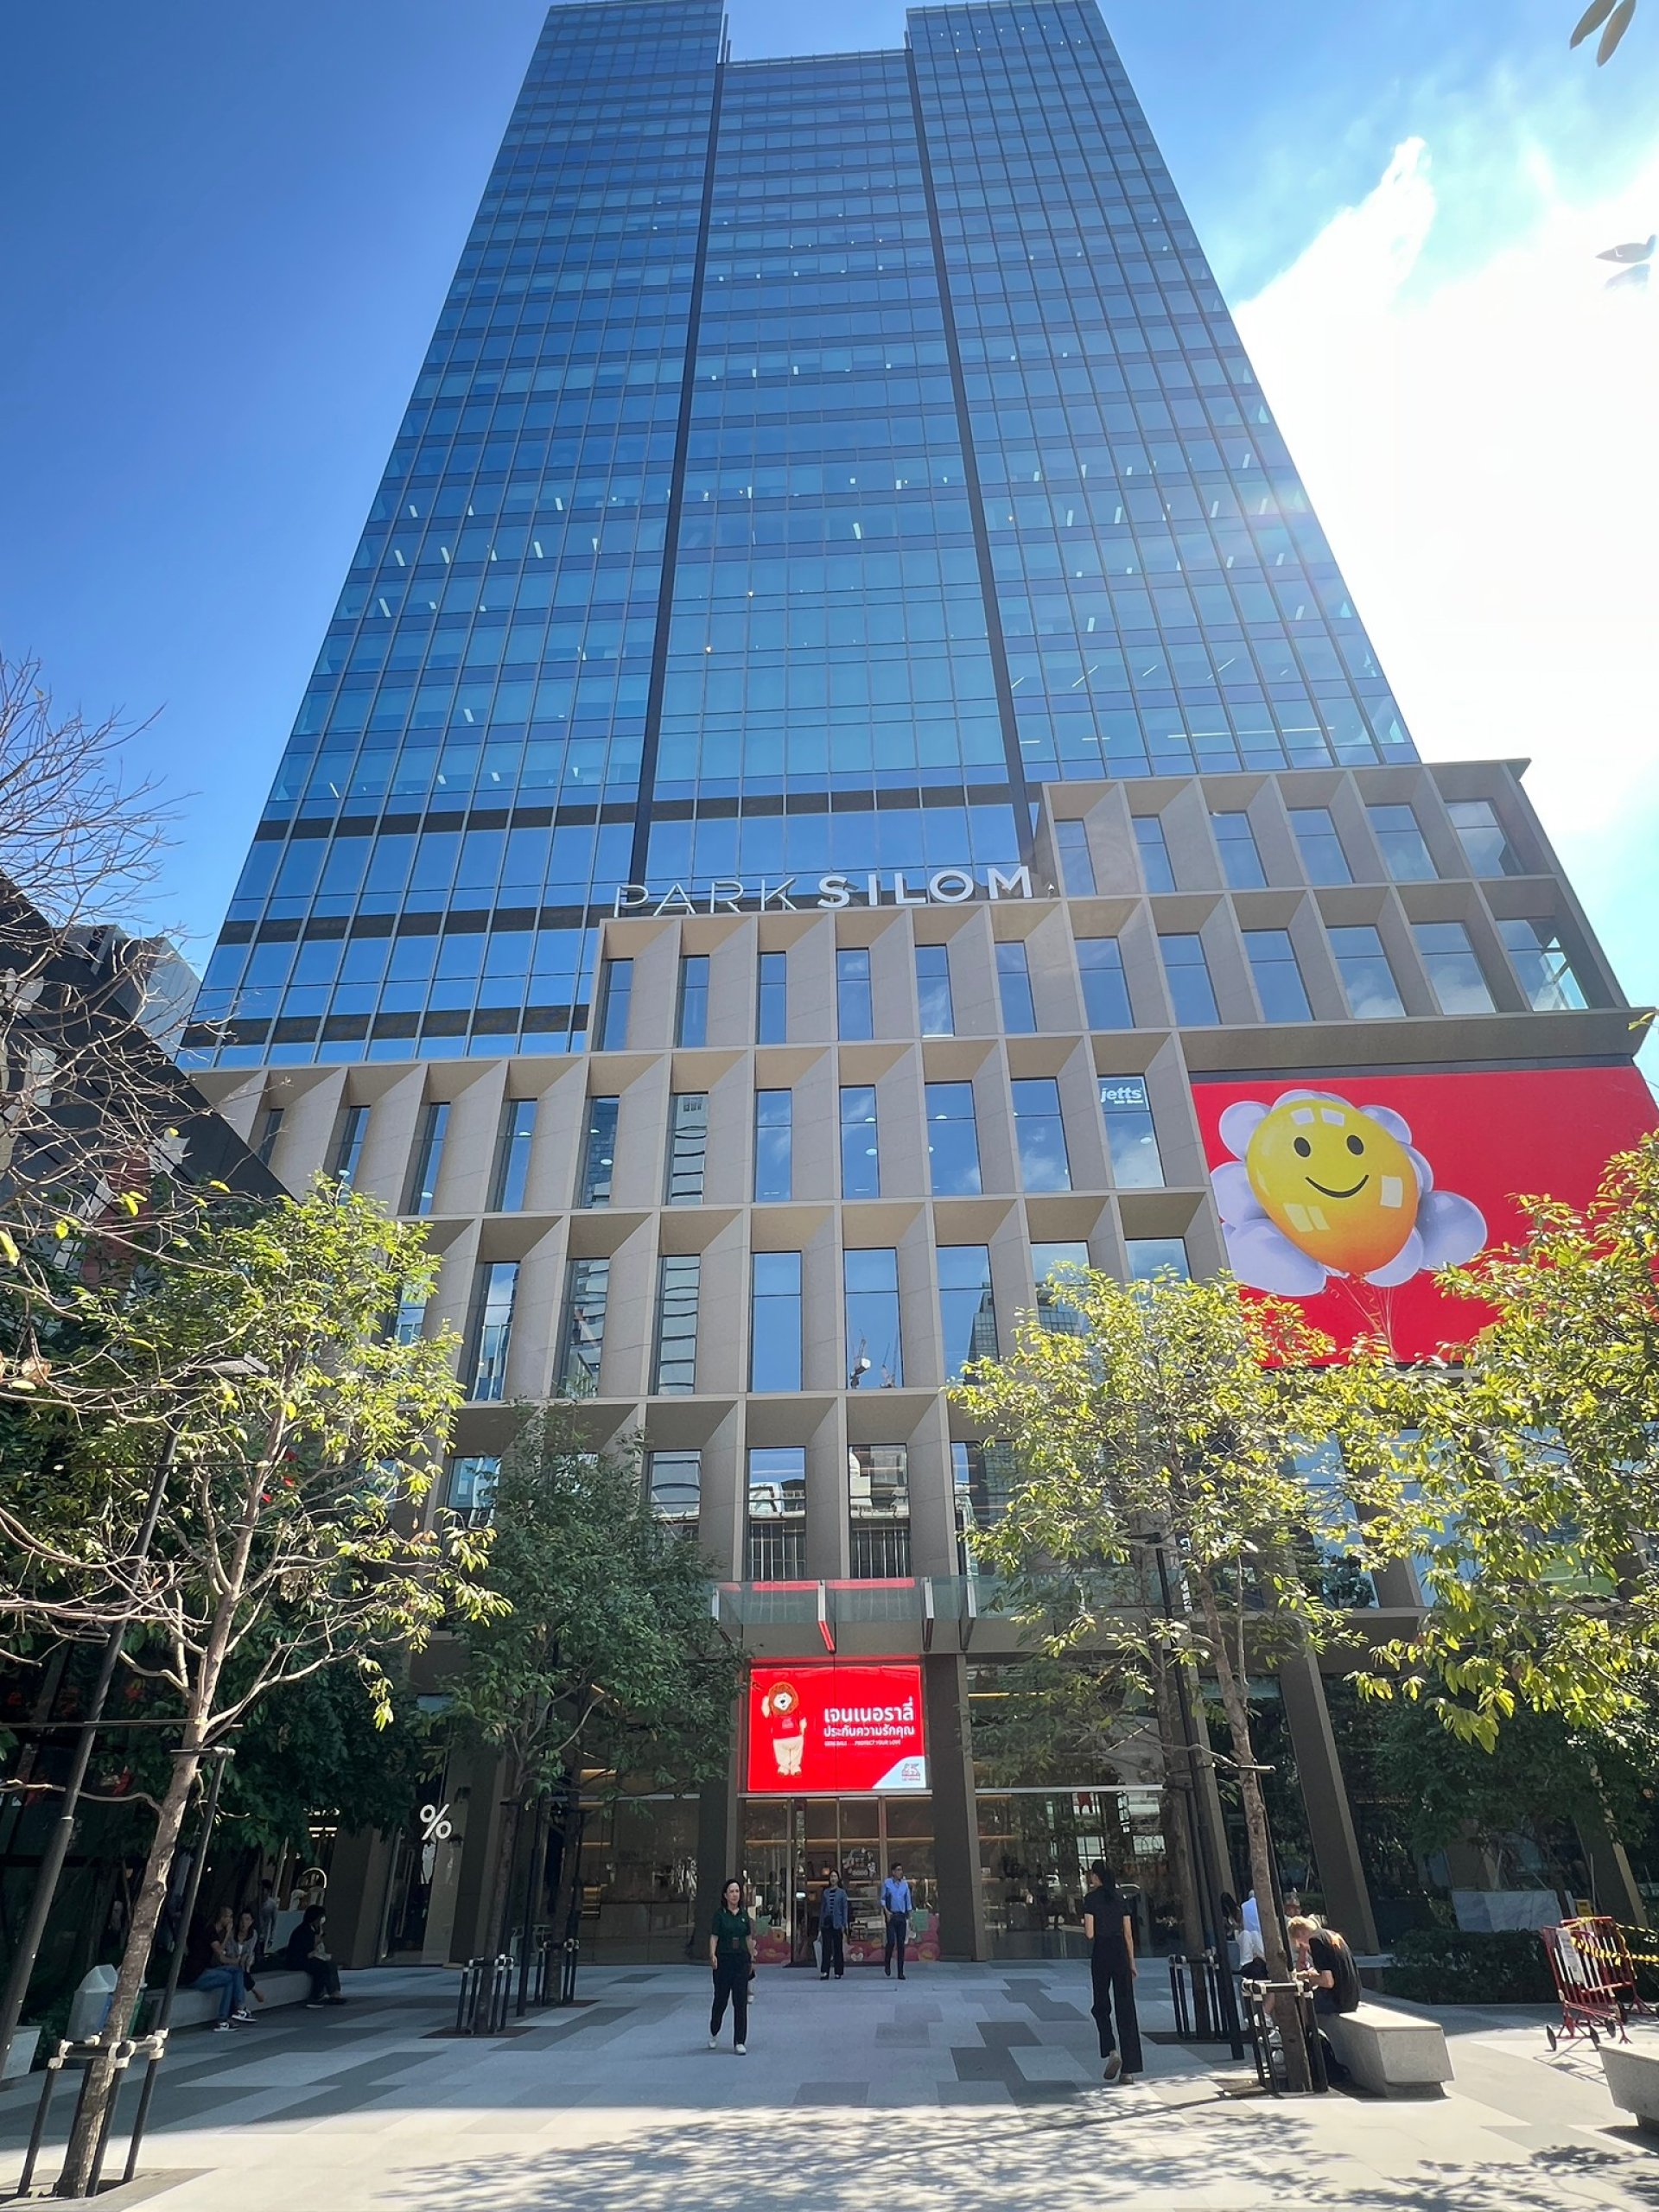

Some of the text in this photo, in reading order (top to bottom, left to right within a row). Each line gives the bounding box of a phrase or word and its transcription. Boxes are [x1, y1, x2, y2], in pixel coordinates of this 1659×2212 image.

[613, 865, 1033, 918] PARK SILOM
[1100, 1087, 1141, 1103] jetts
[824, 1696, 914, 1722] เจนเนอราลี่
[420, 1803, 452, 1840] %
